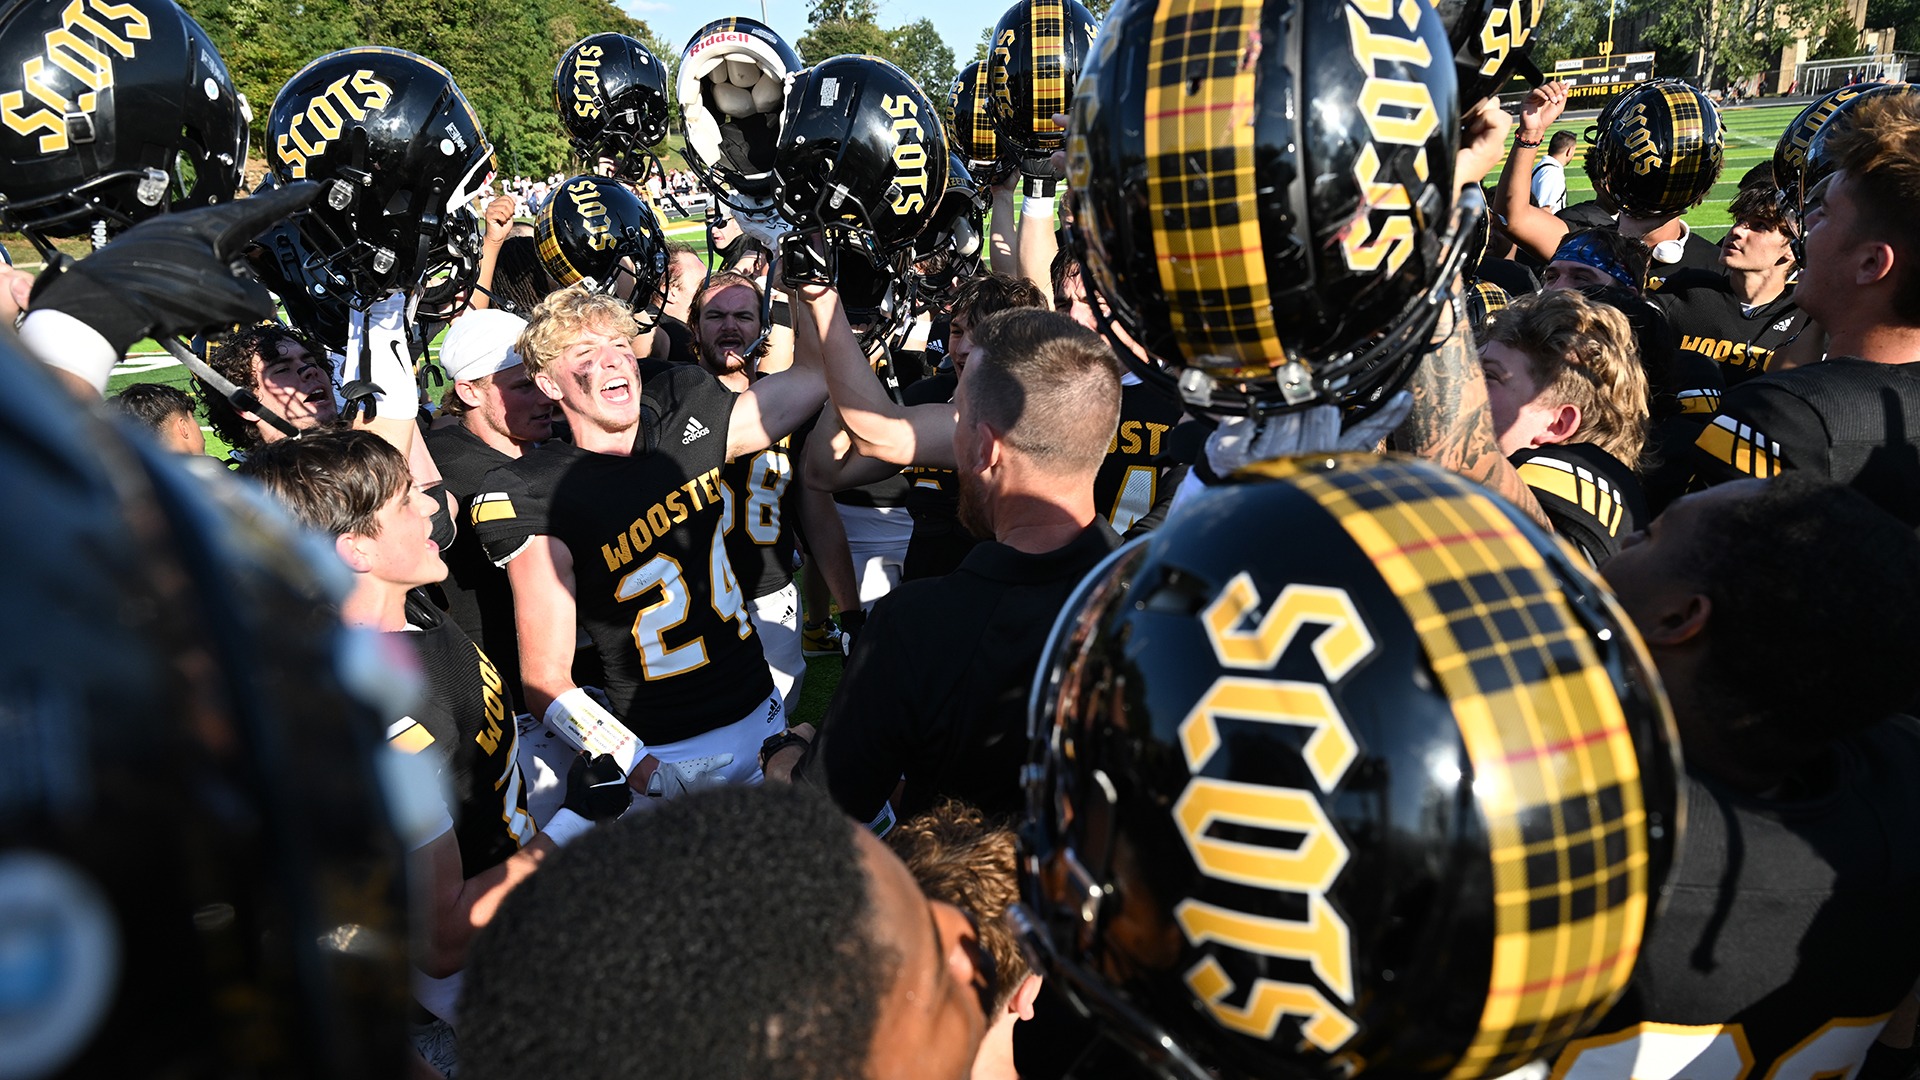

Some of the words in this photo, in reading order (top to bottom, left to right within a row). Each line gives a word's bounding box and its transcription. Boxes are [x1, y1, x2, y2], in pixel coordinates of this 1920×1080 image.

[0, 0, 151, 153] SCOTS
[573, 44, 604, 119] SCOTS
[689, 33, 749, 57] Riddell
[277, 69, 393, 178] SCOTS
[881, 93, 928, 215] SCOTS
[1614, 103, 1662, 176] SCOTS
[566, 180, 618, 251] SCOTS
[681, 427, 710, 445] adidas
[614, 514, 752, 681] 24
[1172, 570, 1376, 1054] SCOTS
